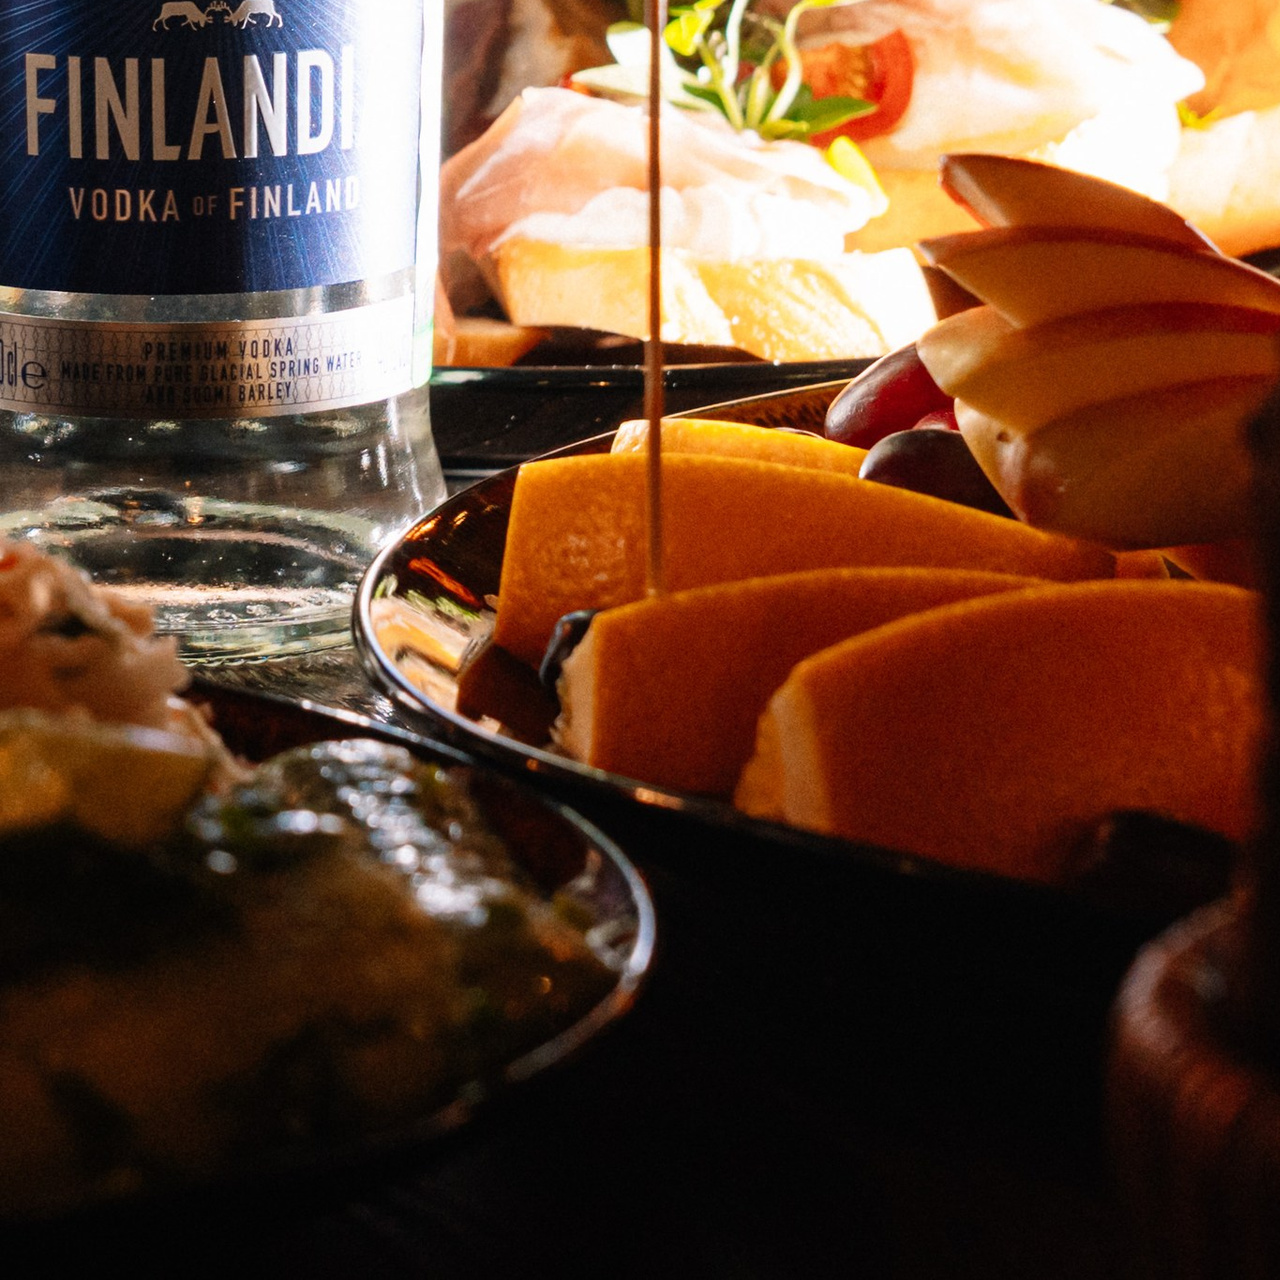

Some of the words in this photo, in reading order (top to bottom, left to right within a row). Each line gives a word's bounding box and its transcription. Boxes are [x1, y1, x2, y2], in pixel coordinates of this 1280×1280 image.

[24, 45, 355, 161] FINLANDI
[69, 187, 180, 222] VODKA
[192, 195, 218, 216] OF
[229, 175, 361, 221] FINLAND
[144, 340, 227, 361] PREMIUM
[238, 336, 294, 360] VODKA
[61, 359, 100, 381] MADE
[107, 363, 147, 382] FROM
[155, 364, 192, 383] PURE
[200, 362, 263, 382] GLACIAL
[270, 357, 320, 377] SPRING
[325, 349, 362, 372] WATER
[238, 380, 292, 403] BARLEY
